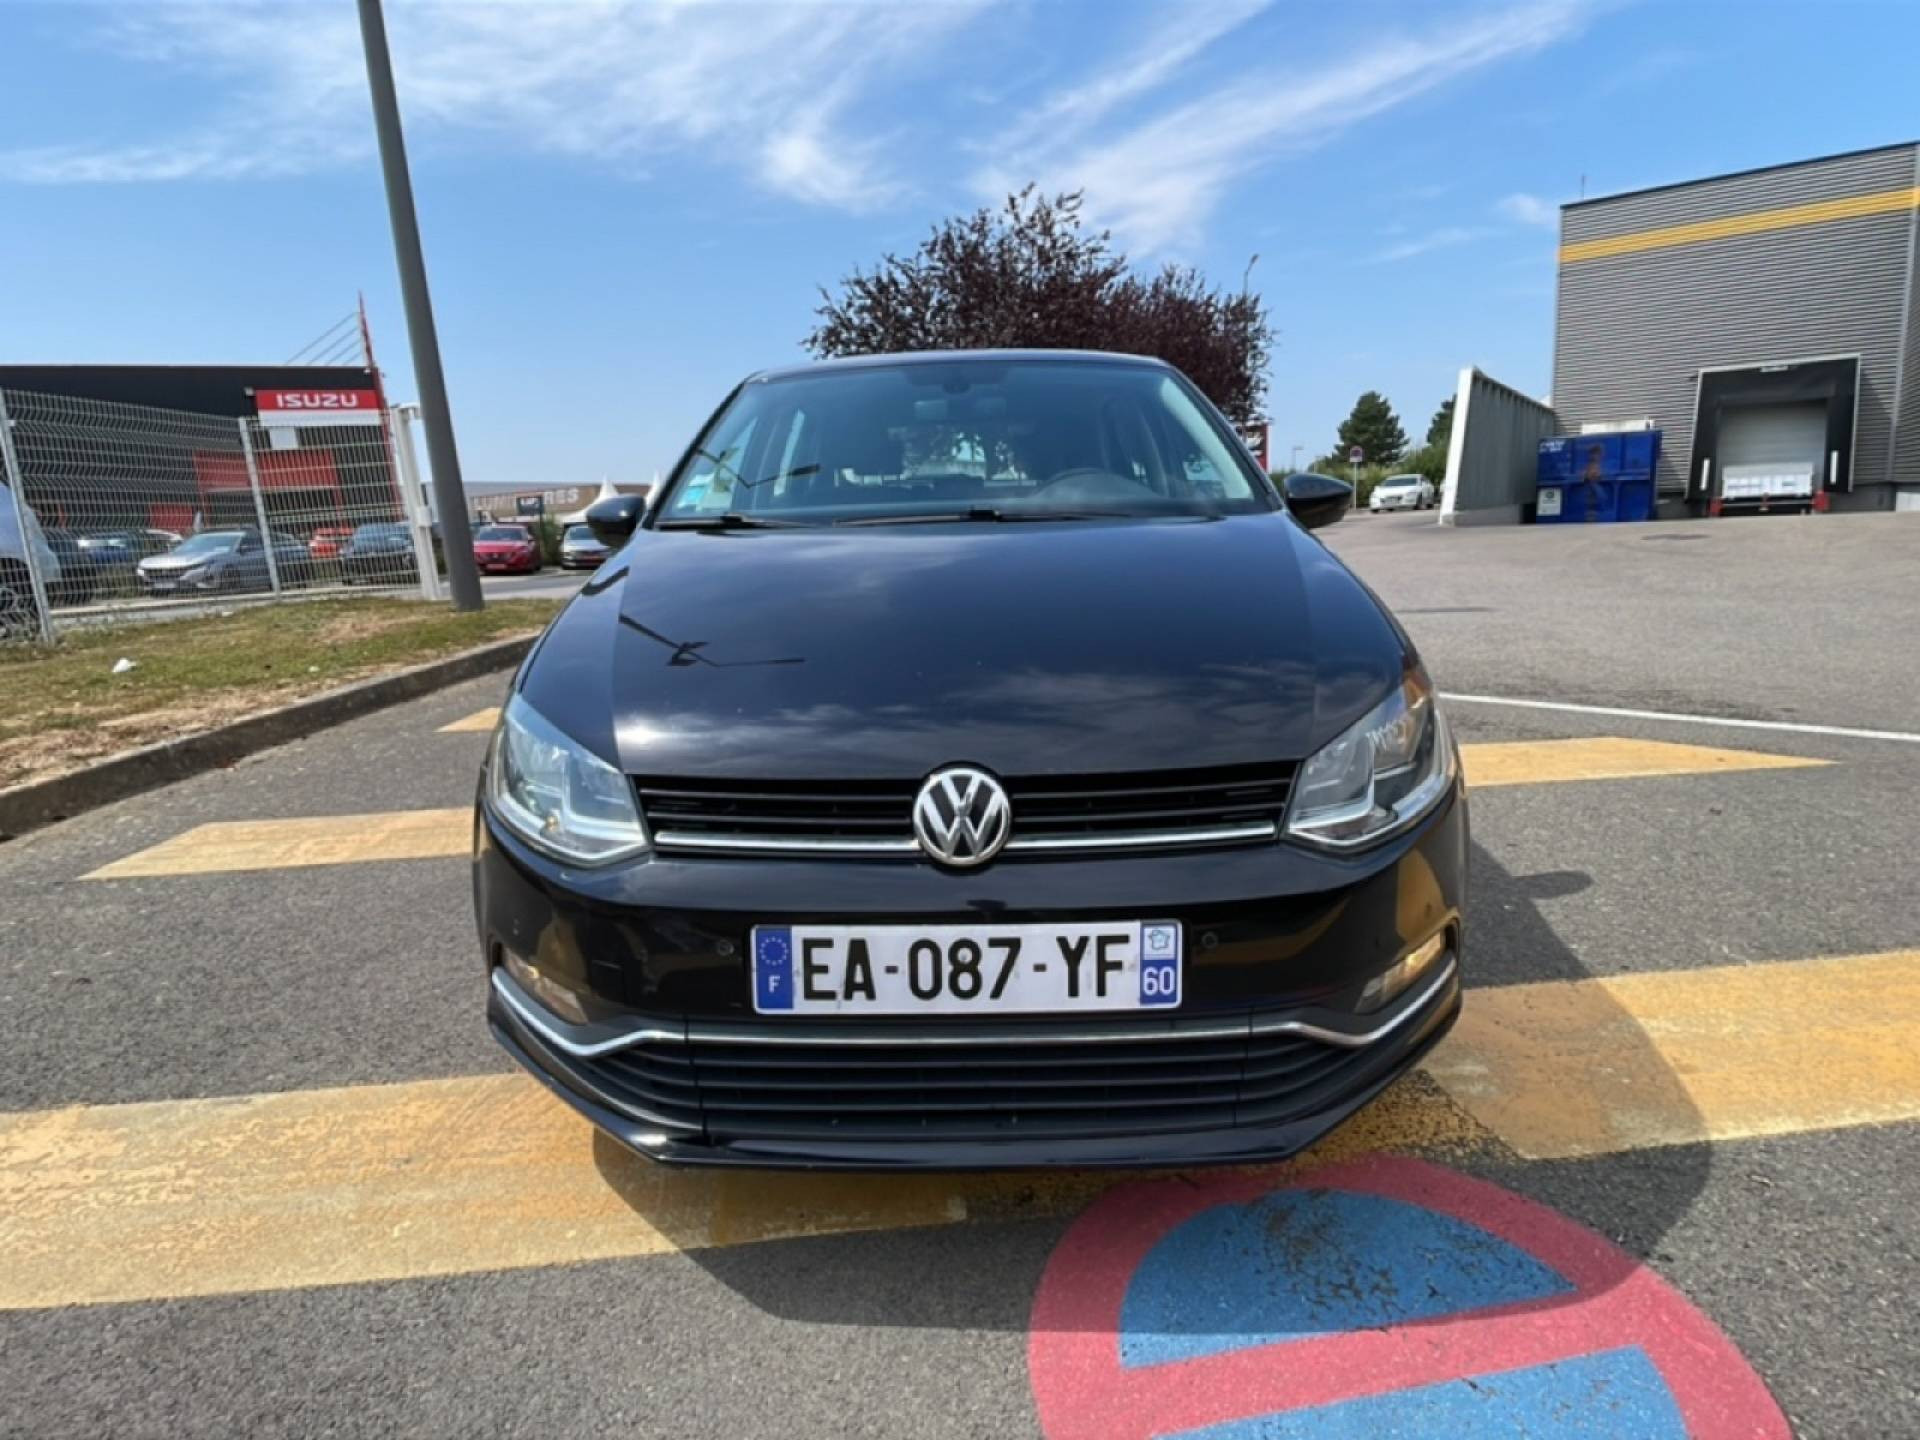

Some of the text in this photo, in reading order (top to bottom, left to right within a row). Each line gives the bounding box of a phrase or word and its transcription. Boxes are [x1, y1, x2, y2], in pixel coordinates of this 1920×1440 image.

[275, 392, 358, 409] ISUZU
[801, 933, 1131, 1001] EA-087-YF
[767, 974, 782, 994] F
[1143, 965, 1176, 997] 60
